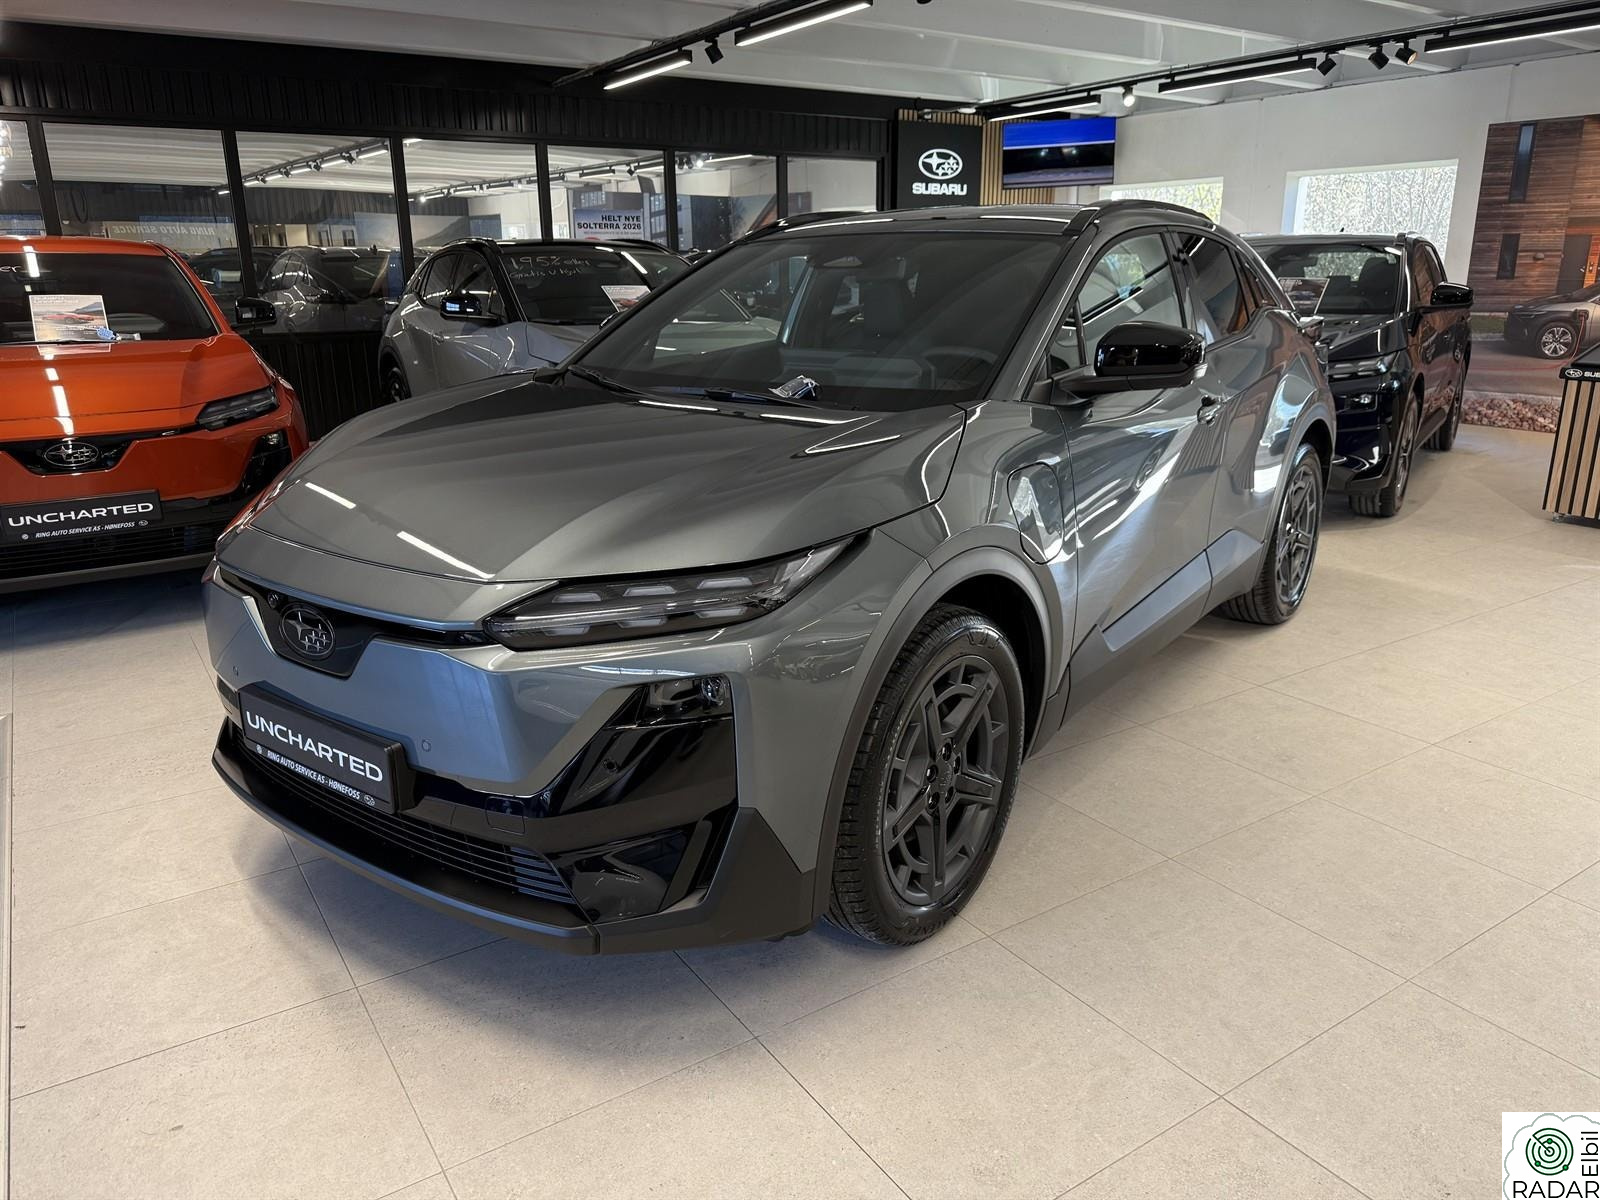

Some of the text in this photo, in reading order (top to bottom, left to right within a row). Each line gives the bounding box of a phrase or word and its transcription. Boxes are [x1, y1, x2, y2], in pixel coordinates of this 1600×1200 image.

[912, 182, 967, 195] SUBARU
[577, 222, 620, 230] SOLTERRA
[8, 502, 154, 527] UNCHARTED
[35, 531, 51, 539] RING
[51, 528, 68, 537] AUTO
[68, 525, 92, 535] SERVICE
[246, 711, 383, 782] UNCHARTED
[267, 750, 280, 763] RING
[280, 757, 295, 769] AUTO
[295, 763, 317, 781] SERVICE
[317, 773, 326, 784] AS
[328, 779, 361, 800] HØNEFOSS
